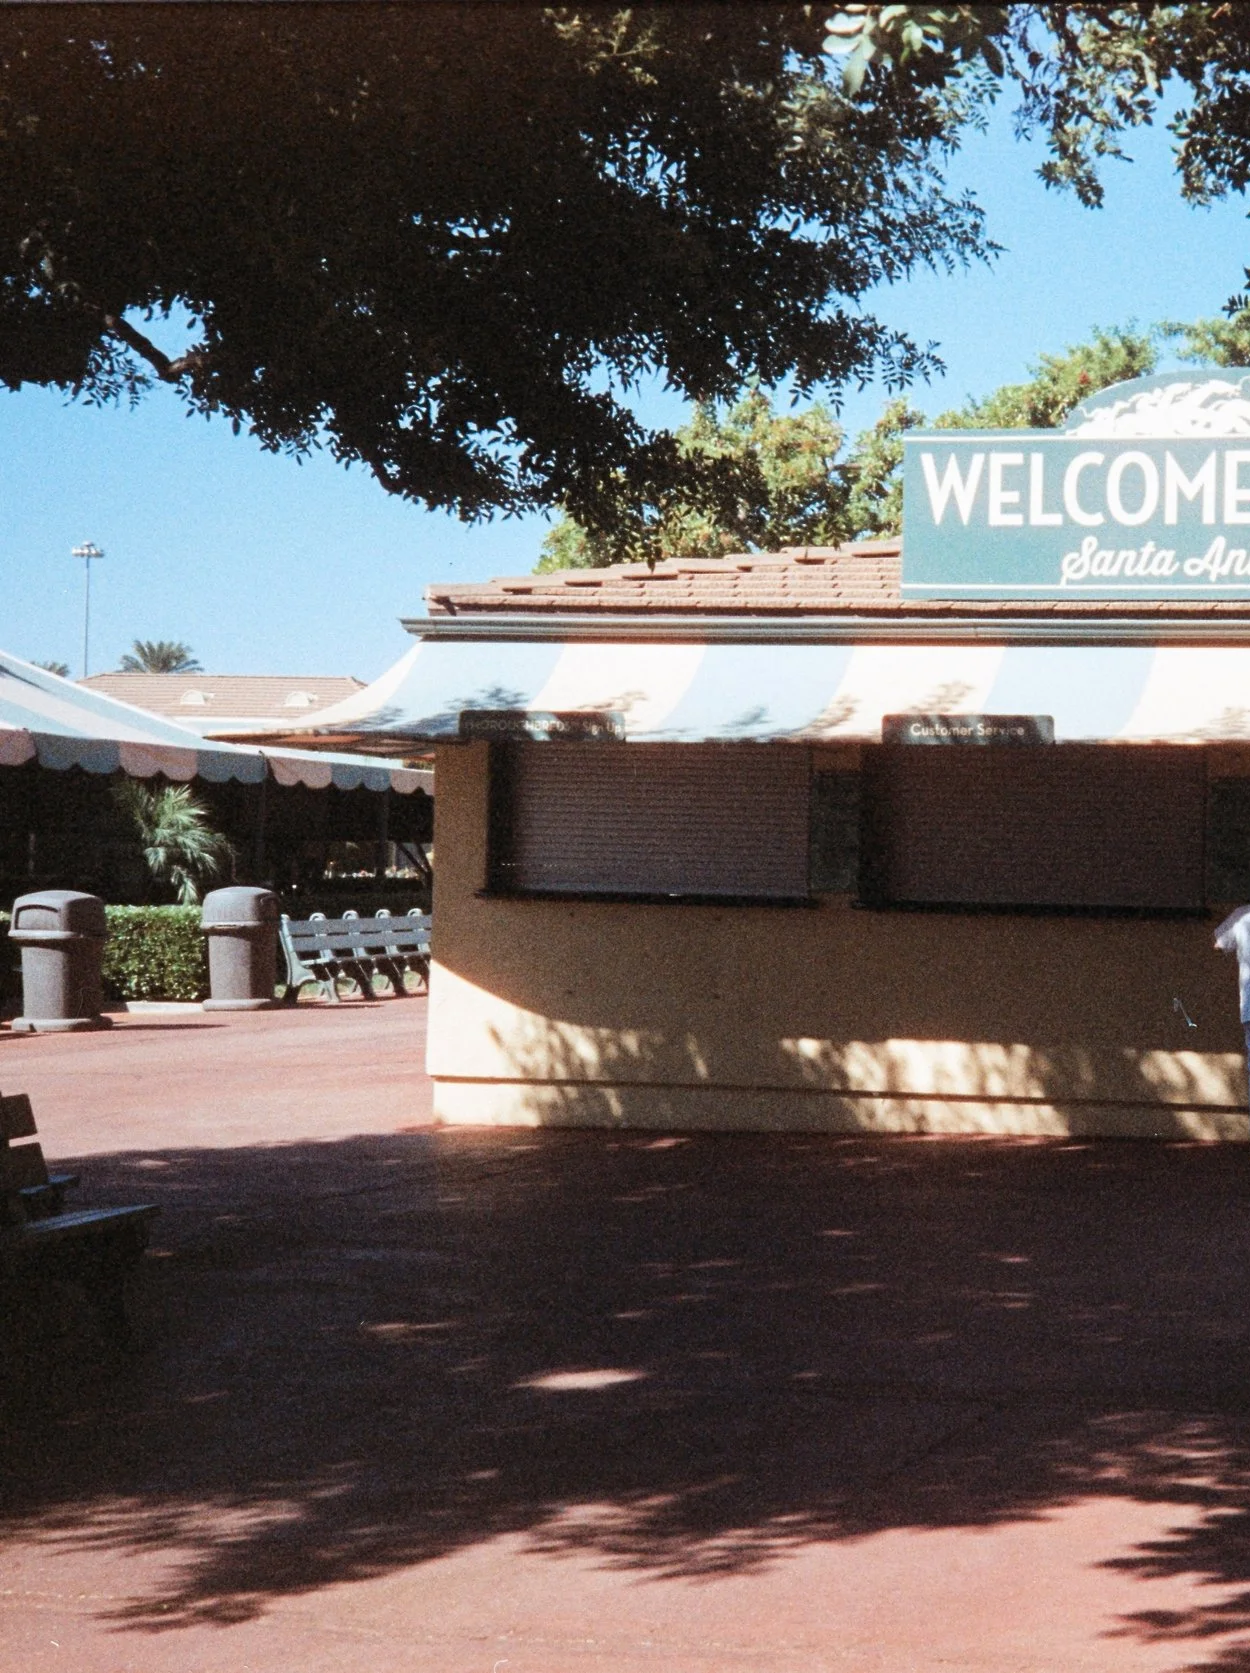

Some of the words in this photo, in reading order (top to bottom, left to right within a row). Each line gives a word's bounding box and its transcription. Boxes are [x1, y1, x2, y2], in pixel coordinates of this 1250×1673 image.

[1060, 535, 1180, 586] Santa
[909, 723, 973, 737] Customer
[977, 723, 1025, 737] Service
